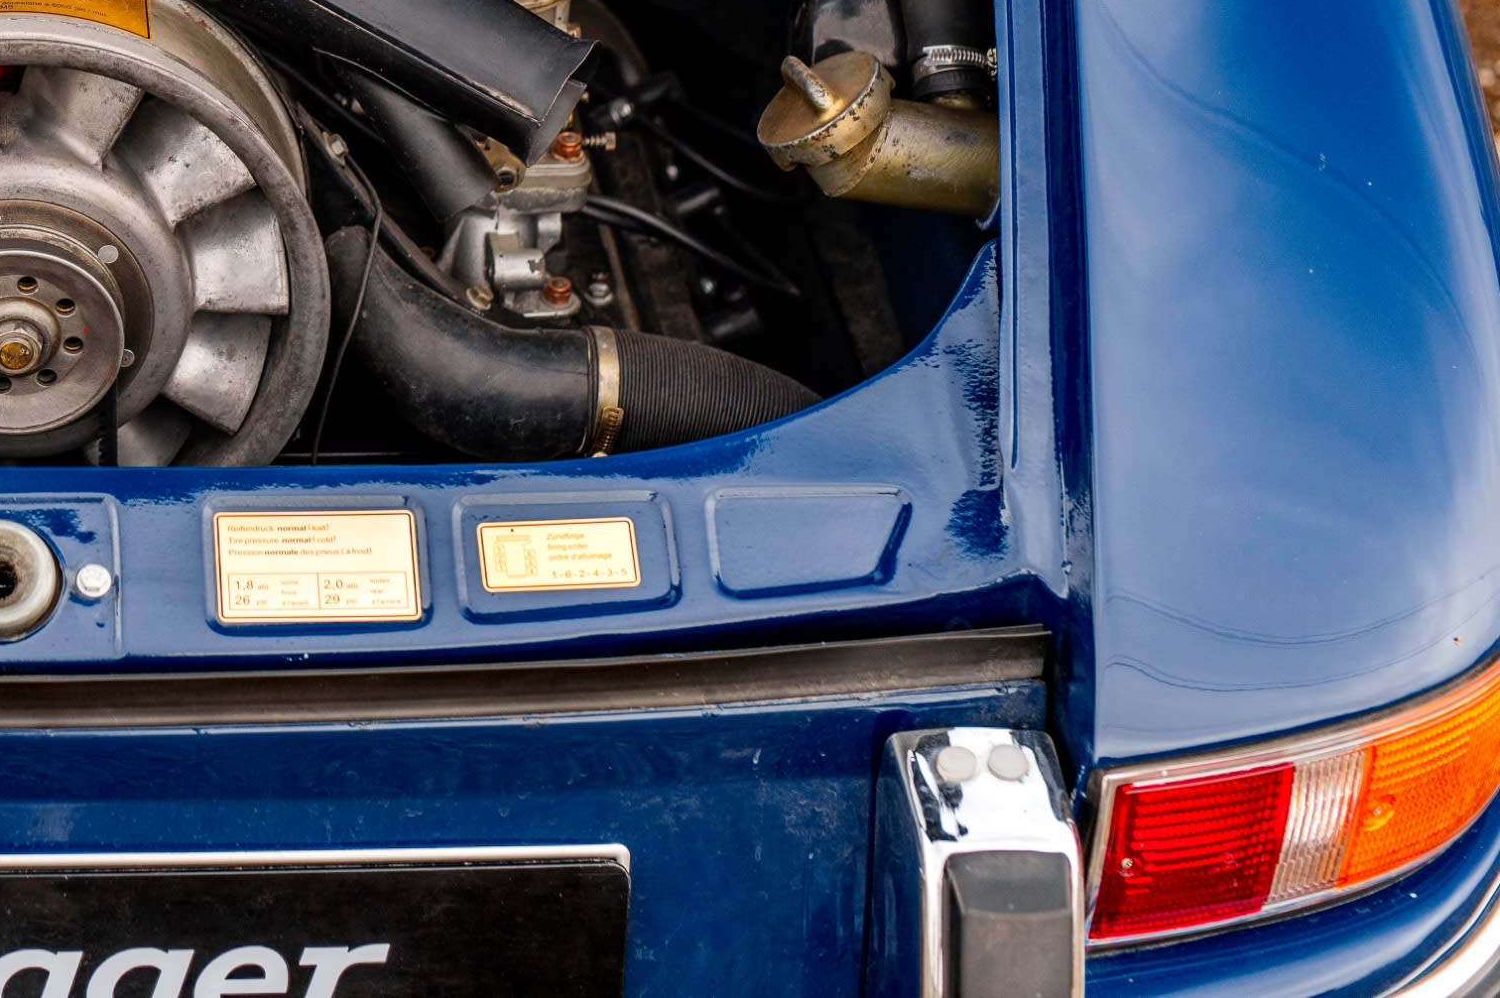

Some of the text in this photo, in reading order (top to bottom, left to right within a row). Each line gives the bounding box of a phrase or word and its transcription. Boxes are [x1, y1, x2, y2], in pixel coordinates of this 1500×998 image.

[276, 524, 308, 532] normal
[280, 536, 312, 544] normal
[264, 548, 300, 556] normale
[234, 594, 252, 606] 26
[324, 593, 342, 605] 29
